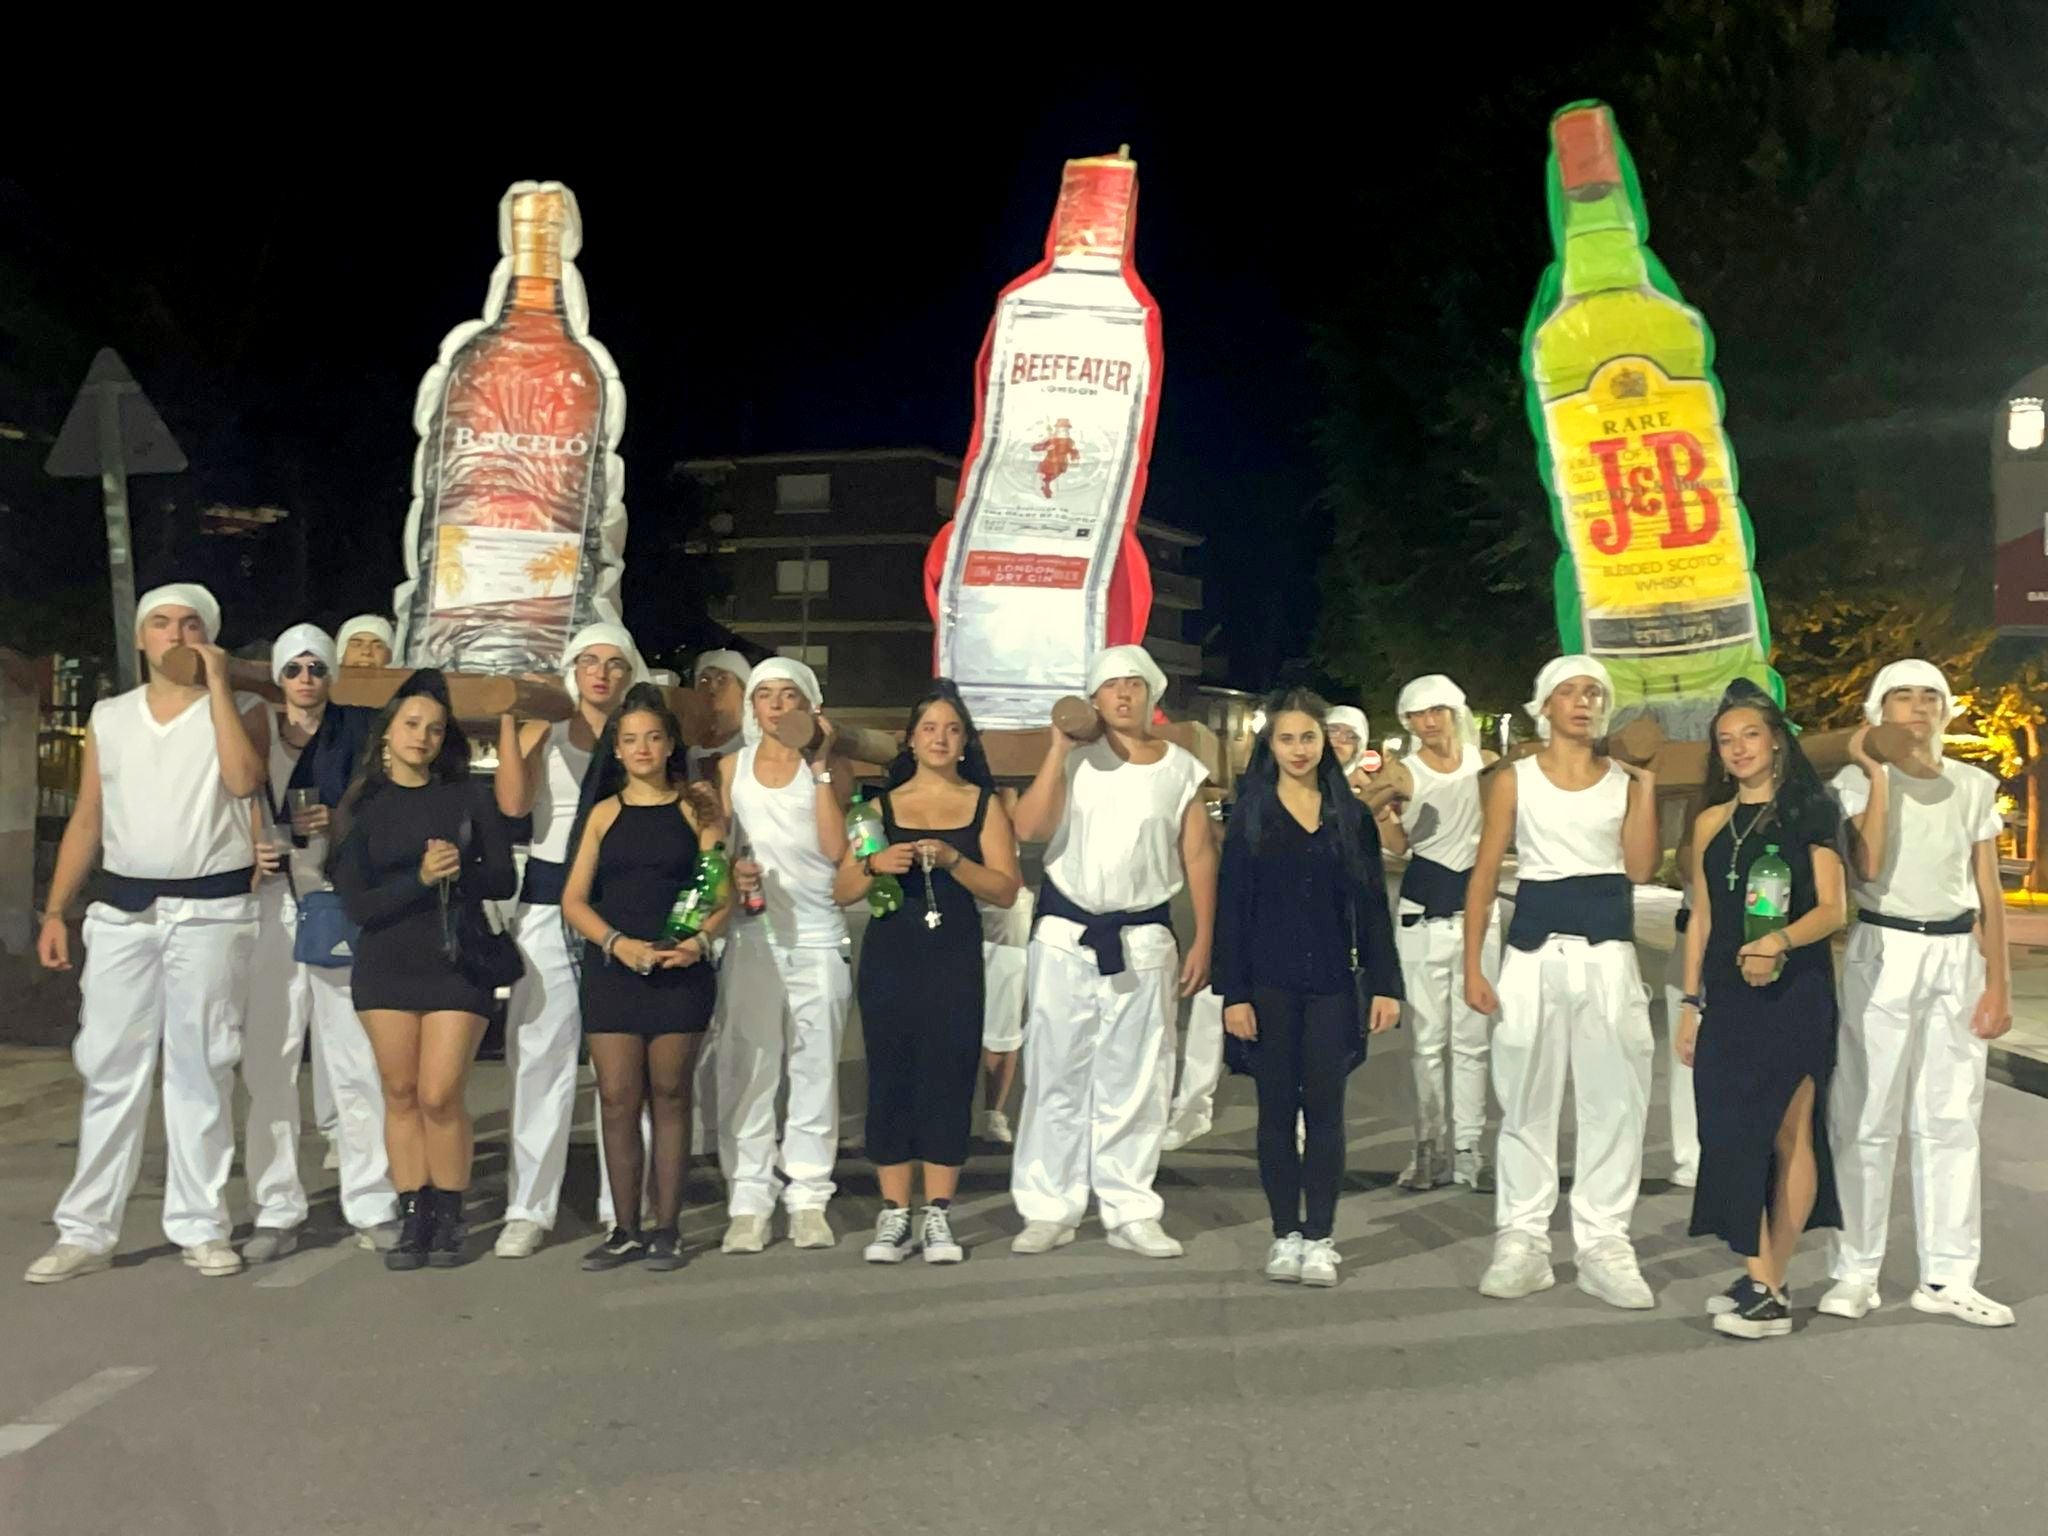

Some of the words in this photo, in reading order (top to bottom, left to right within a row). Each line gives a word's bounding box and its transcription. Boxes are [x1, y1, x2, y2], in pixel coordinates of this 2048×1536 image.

[1011, 353, 1132, 395] BEEFEATER
[1602, 411, 1672, 434] RARE
[1589, 430, 1721, 555] J&B
[995, 572, 1022, 583] DRY
[997, 564, 1056, 575] LONDON
[1634, 576, 1697, 591] WHISKY
